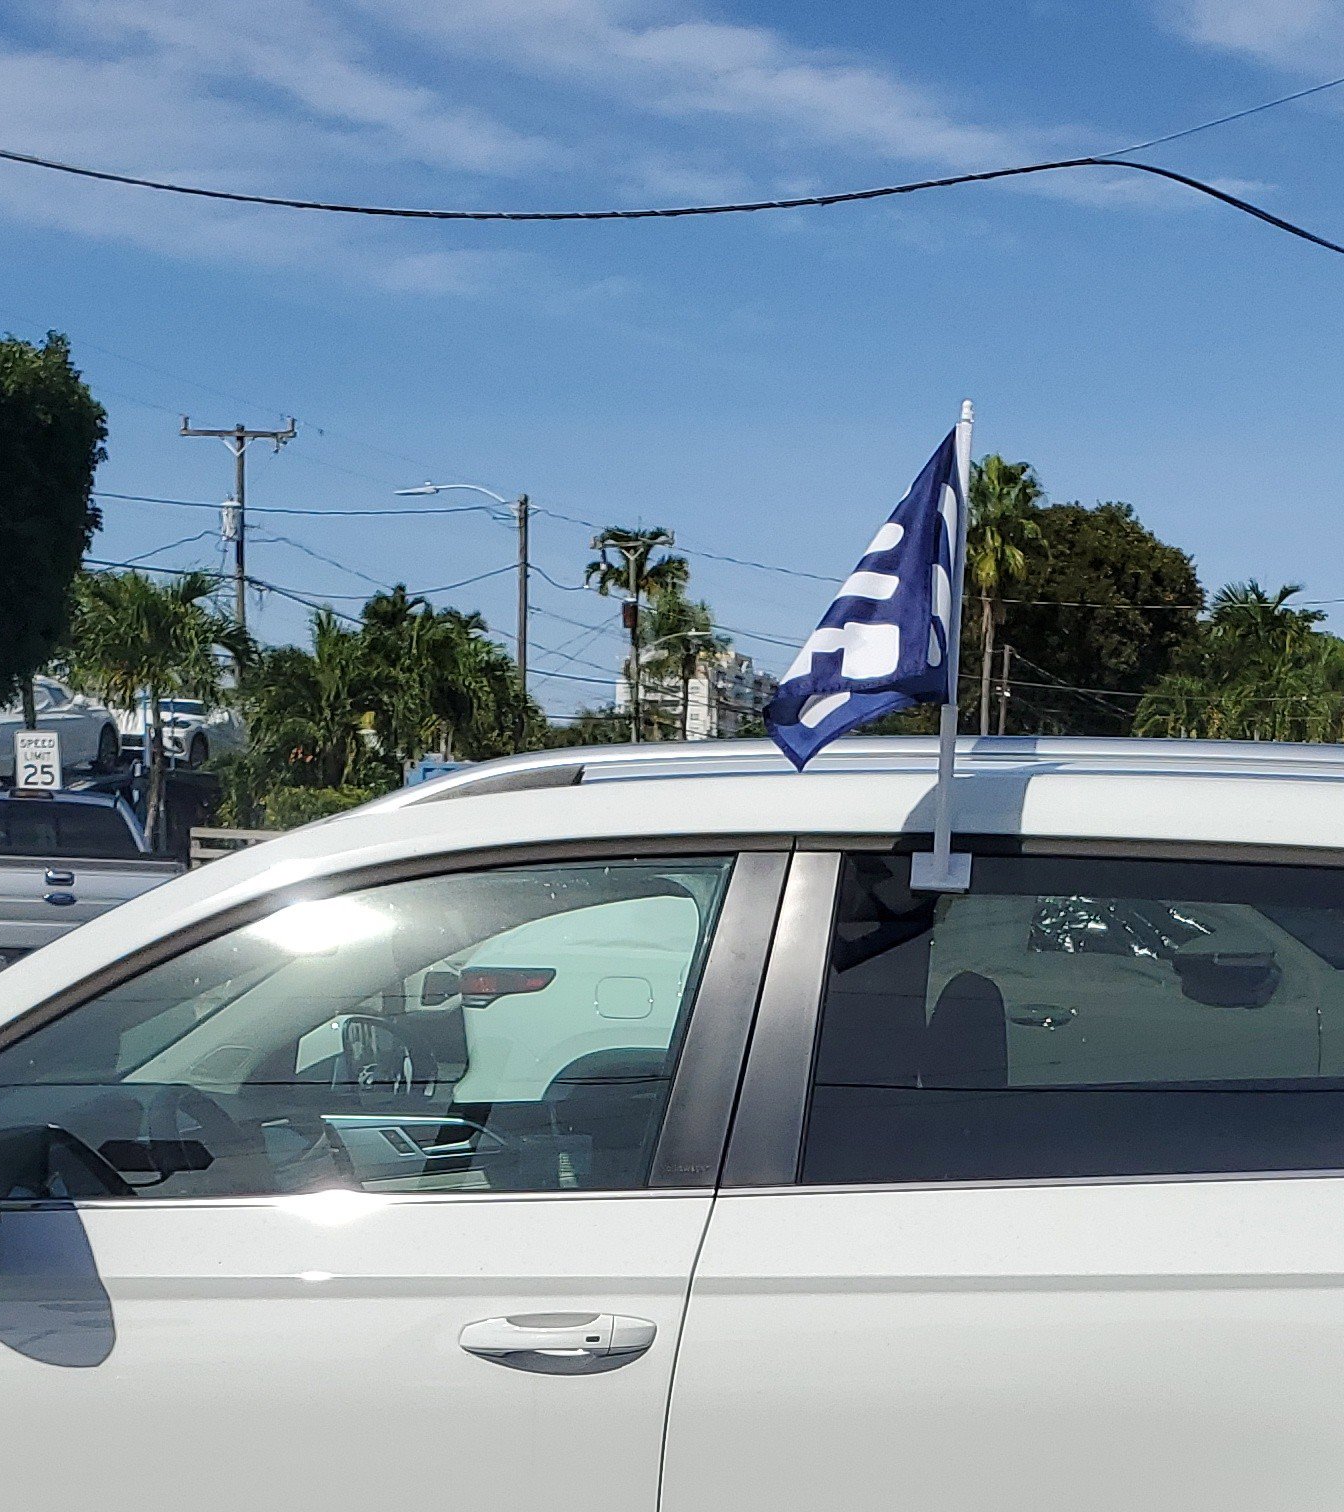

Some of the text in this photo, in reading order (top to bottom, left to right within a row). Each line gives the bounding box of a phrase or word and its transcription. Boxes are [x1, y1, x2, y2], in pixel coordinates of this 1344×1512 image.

[19, 738, 55, 748] SPEED
[24, 751, 51, 761] LIMIT
[24, 764, 55, 785] 25
